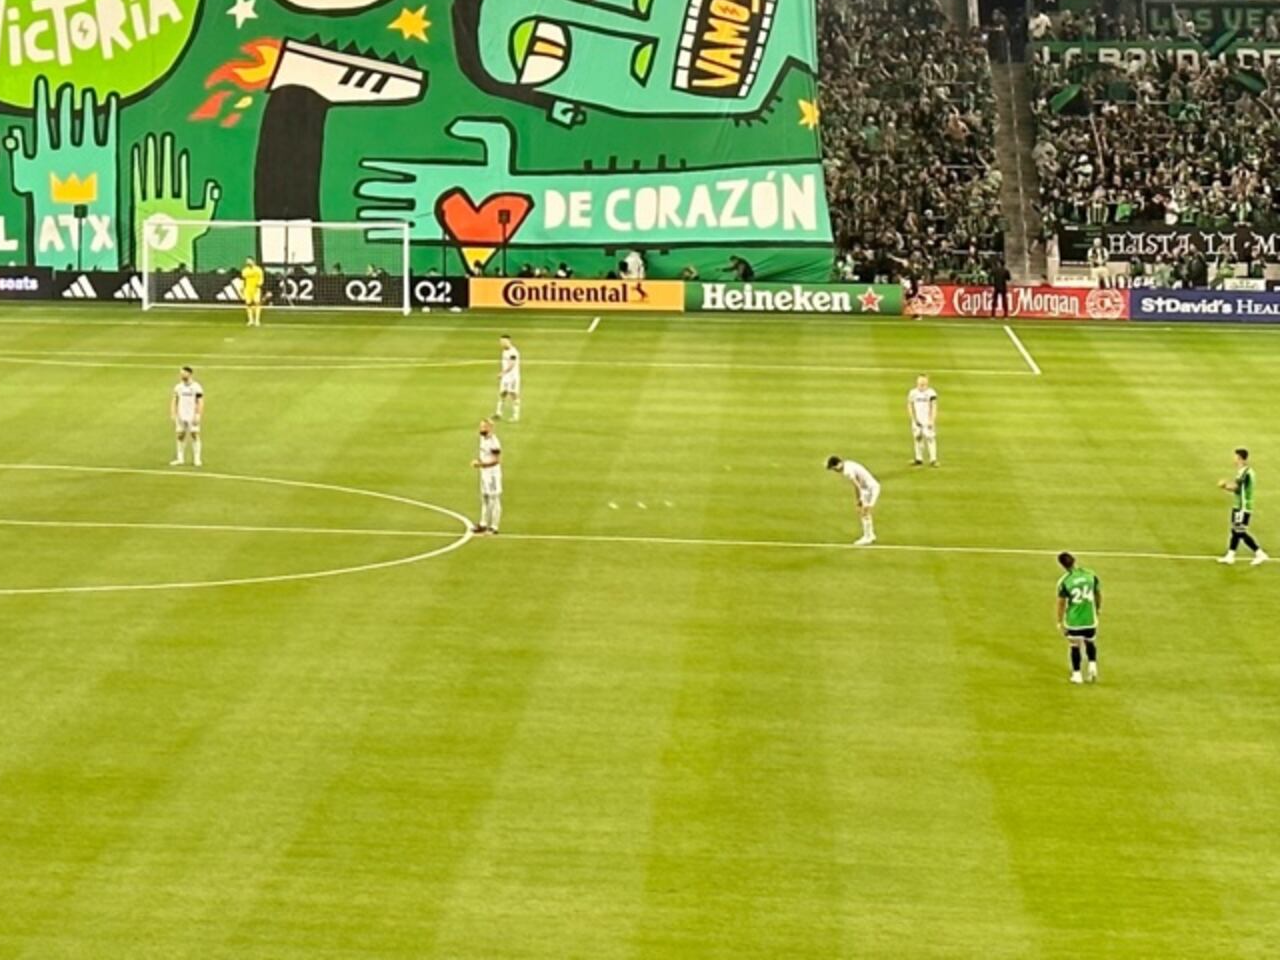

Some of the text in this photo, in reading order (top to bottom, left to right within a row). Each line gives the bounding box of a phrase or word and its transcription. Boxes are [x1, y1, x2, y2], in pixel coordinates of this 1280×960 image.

[543, 170, 817, 232] DE CORAZÓN
[345, 279, 382, 302] Q2
[414, 280, 452, 303] Q2
[502, 280, 628, 306] Continental
[701, 282, 852, 311] Heineken
[1011, 287, 1080, 317] Morgan
[1071, 586, 1094, 604] 24
